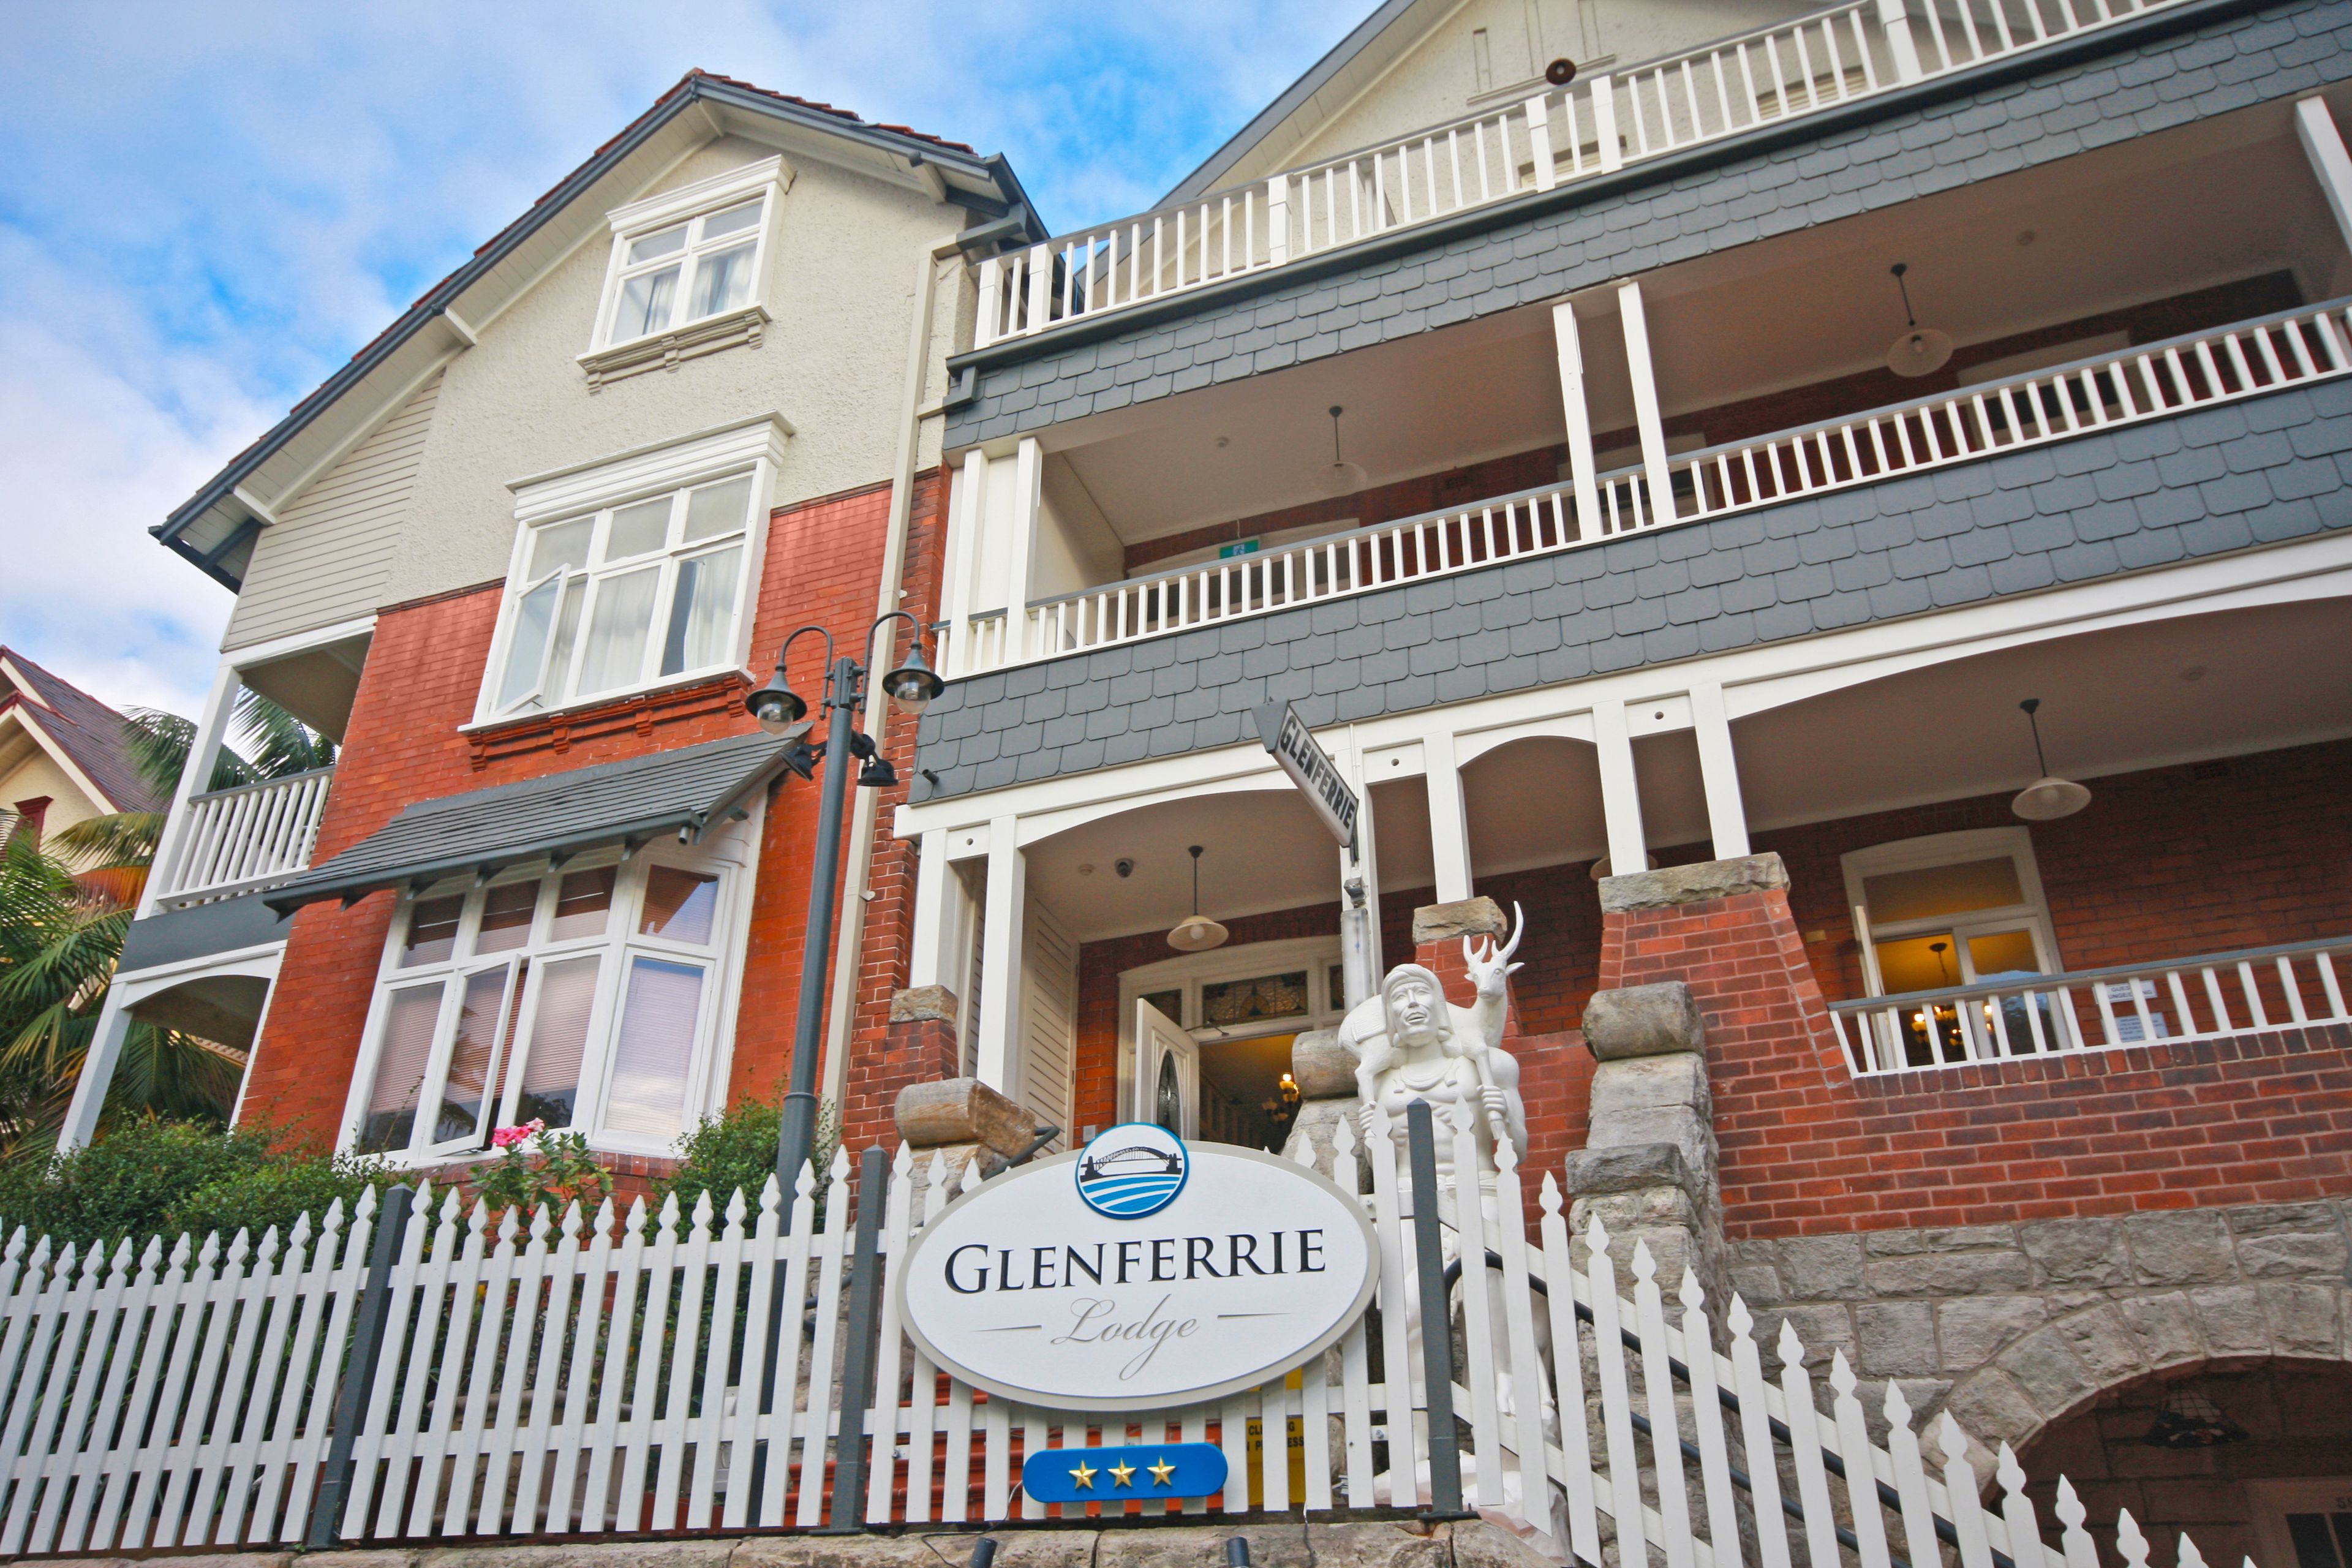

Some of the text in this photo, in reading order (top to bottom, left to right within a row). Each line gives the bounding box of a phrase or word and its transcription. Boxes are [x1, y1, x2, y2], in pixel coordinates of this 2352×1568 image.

[1280, 714, 1355, 830] GLENFERRIE
[944, 1229, 1327, 1295] GLENFERRIE
[1050, 1293, 1200, 1381] Lodge
